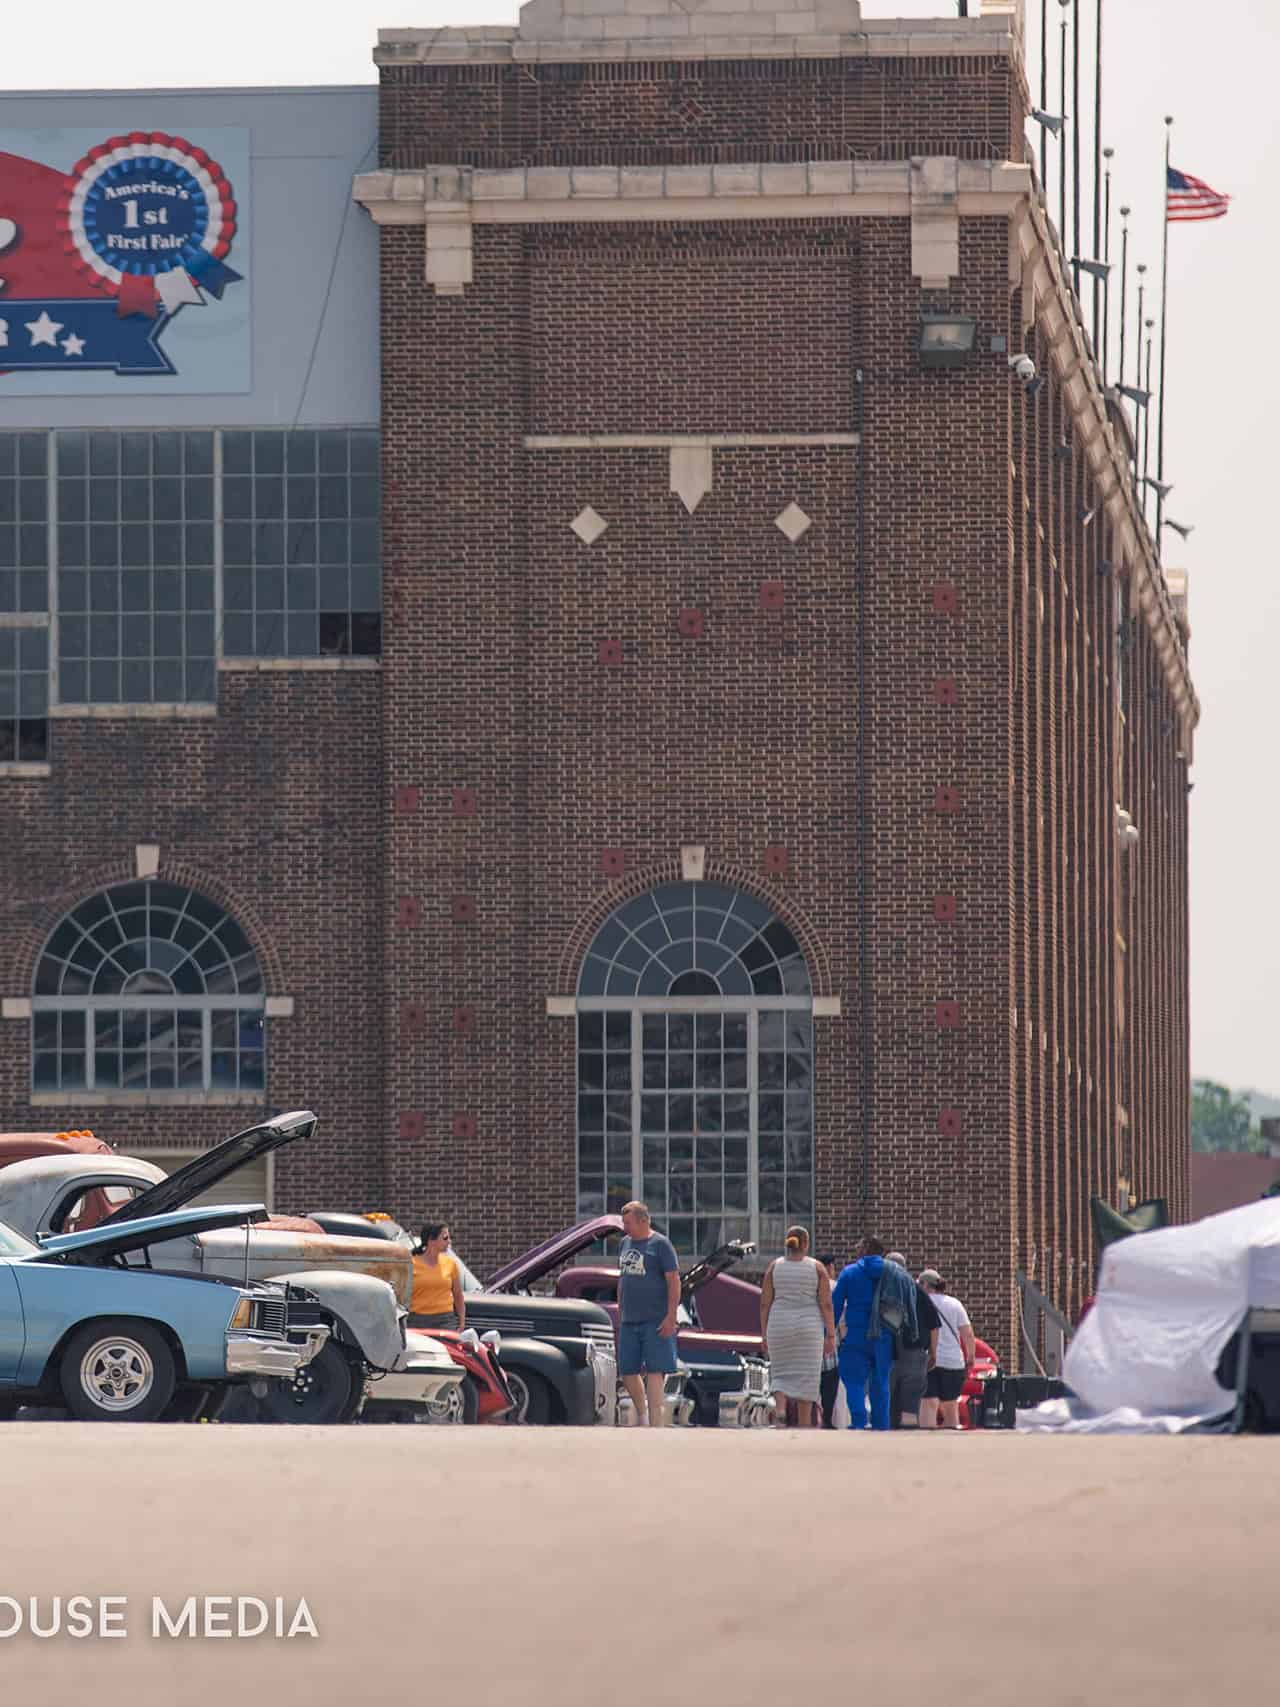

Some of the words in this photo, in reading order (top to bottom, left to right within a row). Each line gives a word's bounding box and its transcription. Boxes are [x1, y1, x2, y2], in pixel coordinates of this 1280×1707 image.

[104, 180, 190, 200] America's
[121, 199, 168, 229] 1st
[106, 233, 147, 249] First
